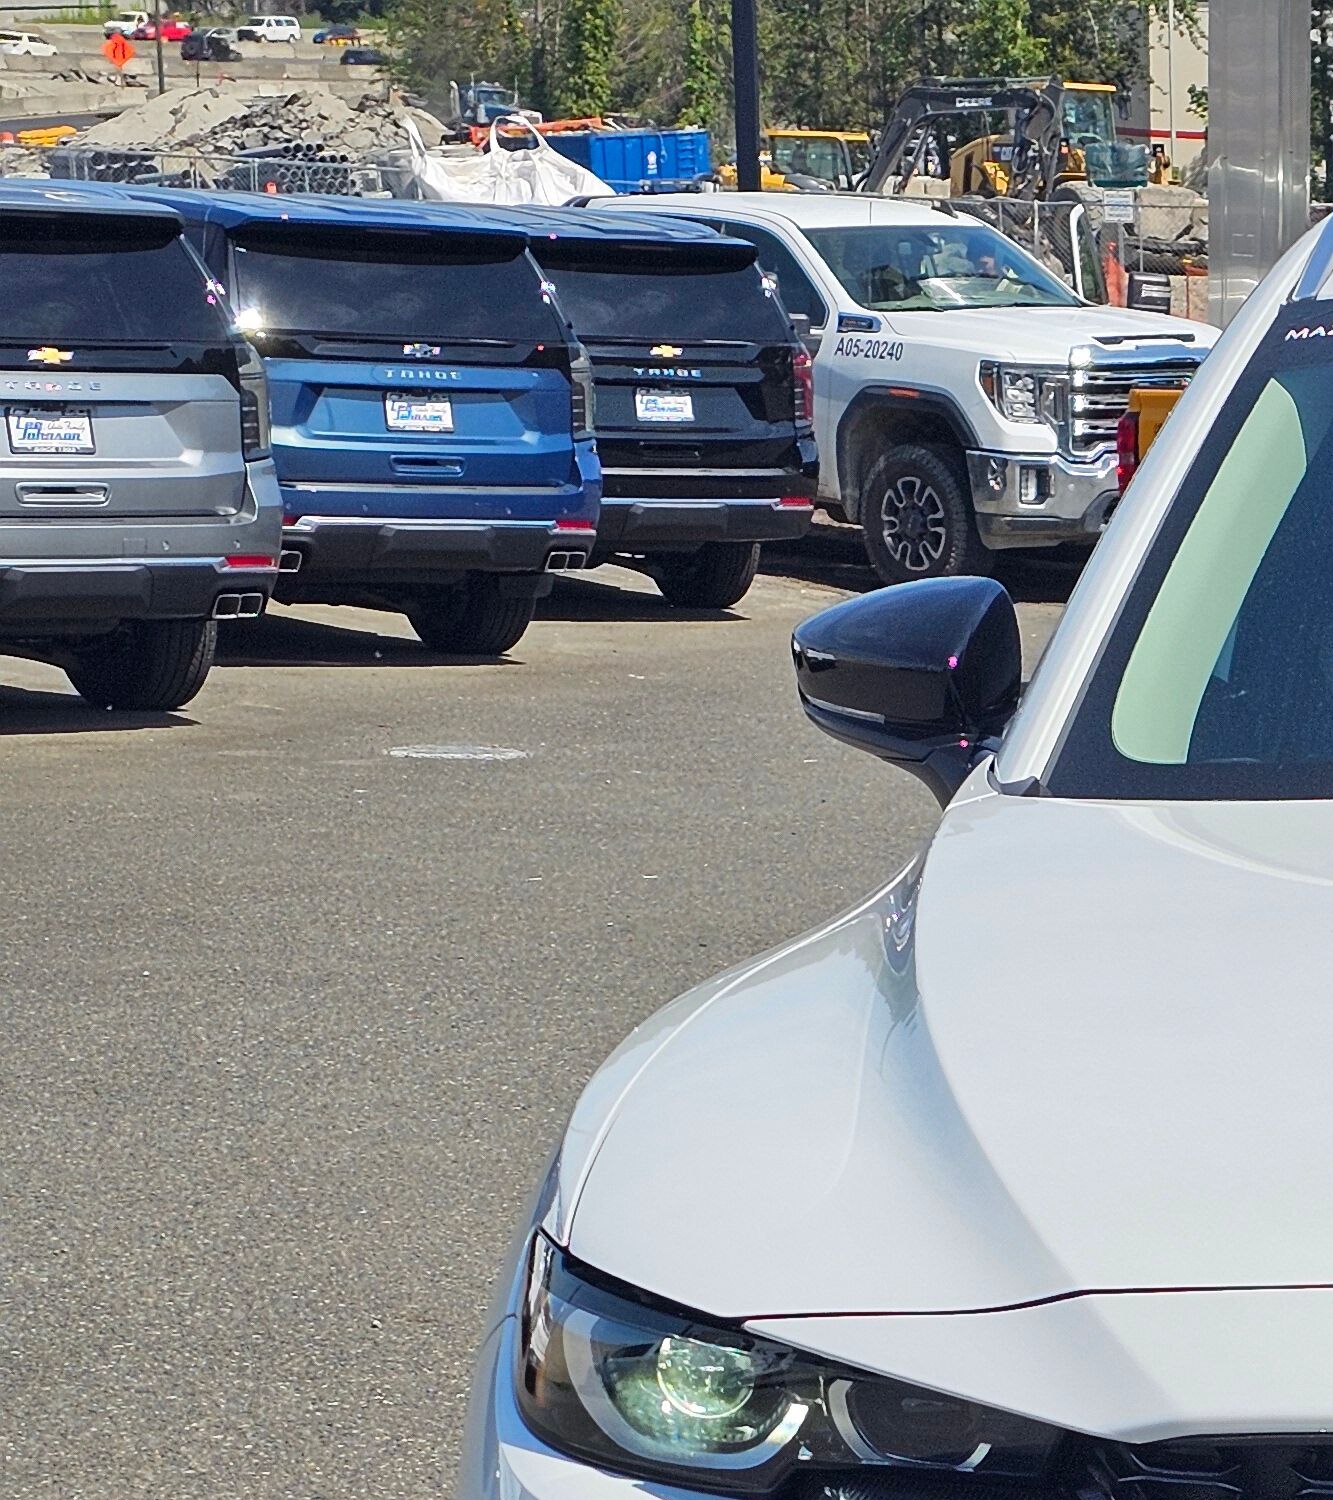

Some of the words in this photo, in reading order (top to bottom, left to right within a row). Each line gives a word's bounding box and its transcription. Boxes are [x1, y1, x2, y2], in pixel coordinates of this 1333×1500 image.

[955, 97, 993, 108] DEERE
[834, 337, 904, 361] A05-20240
[384, 368, 462, 380] TAHOE
[633, 367, 702, 378] TAHOE
